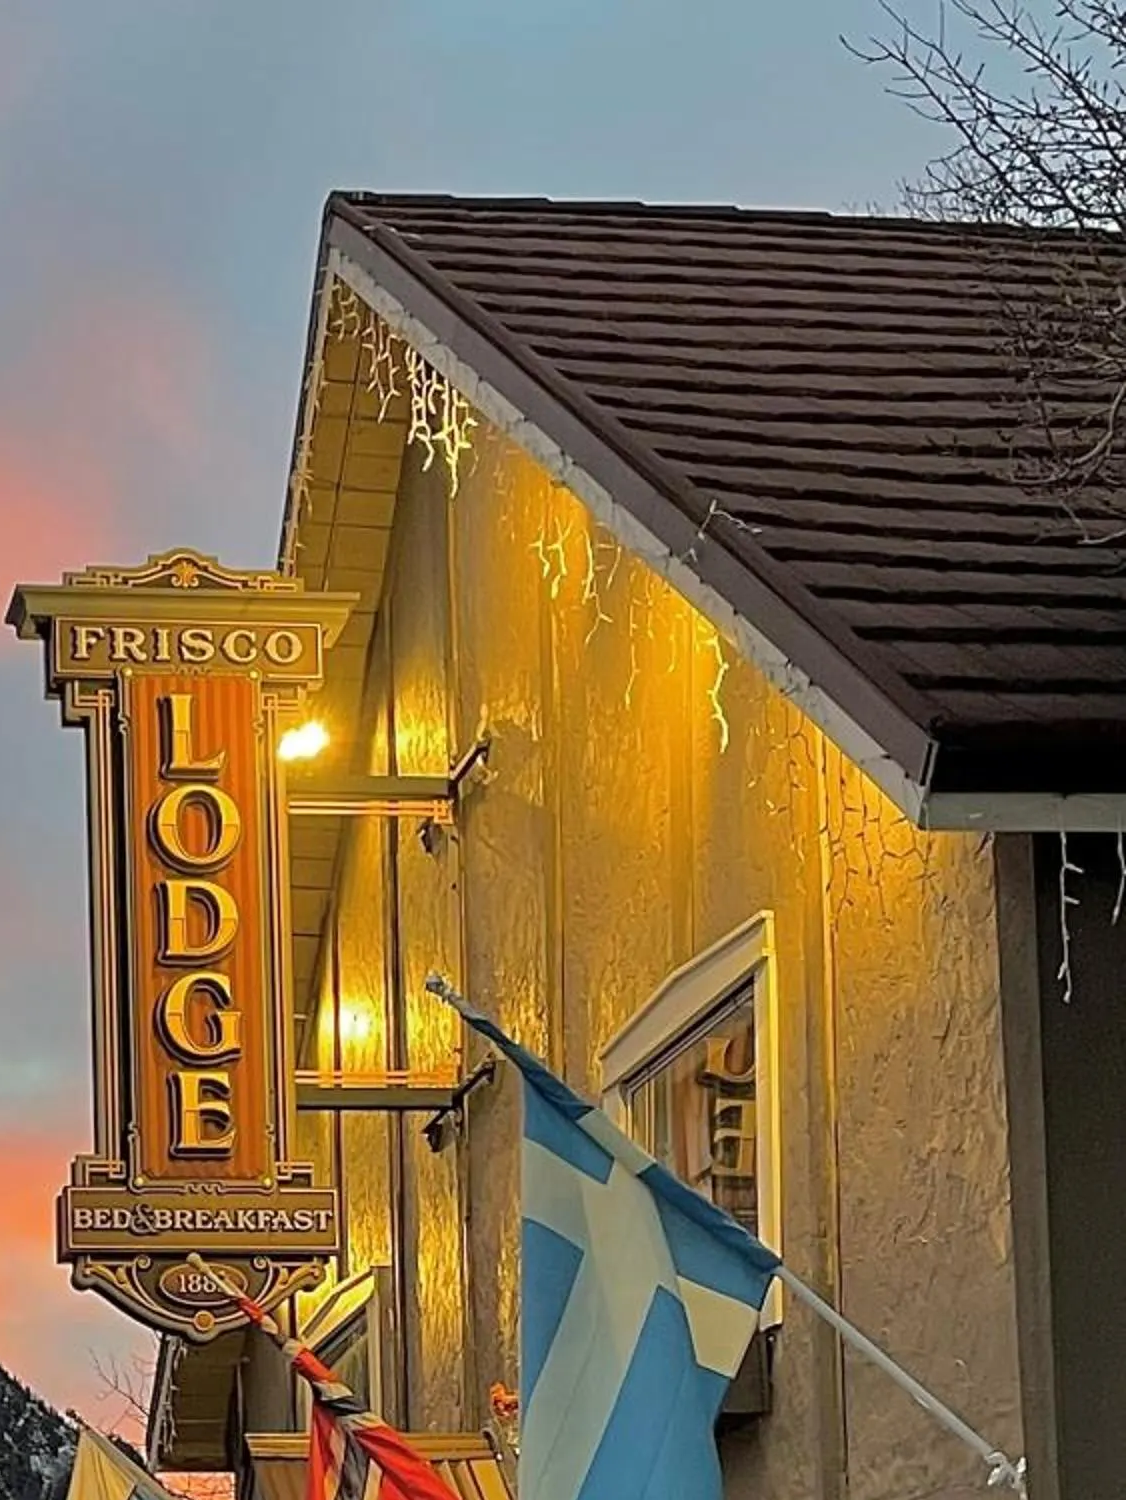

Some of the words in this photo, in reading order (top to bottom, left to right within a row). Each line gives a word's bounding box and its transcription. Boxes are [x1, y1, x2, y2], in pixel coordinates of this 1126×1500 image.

[72, 625, 304, 664] FRISCO
[151, 692, 243, 1154] LODGE
[178, 1271, 228, 1293] 188
